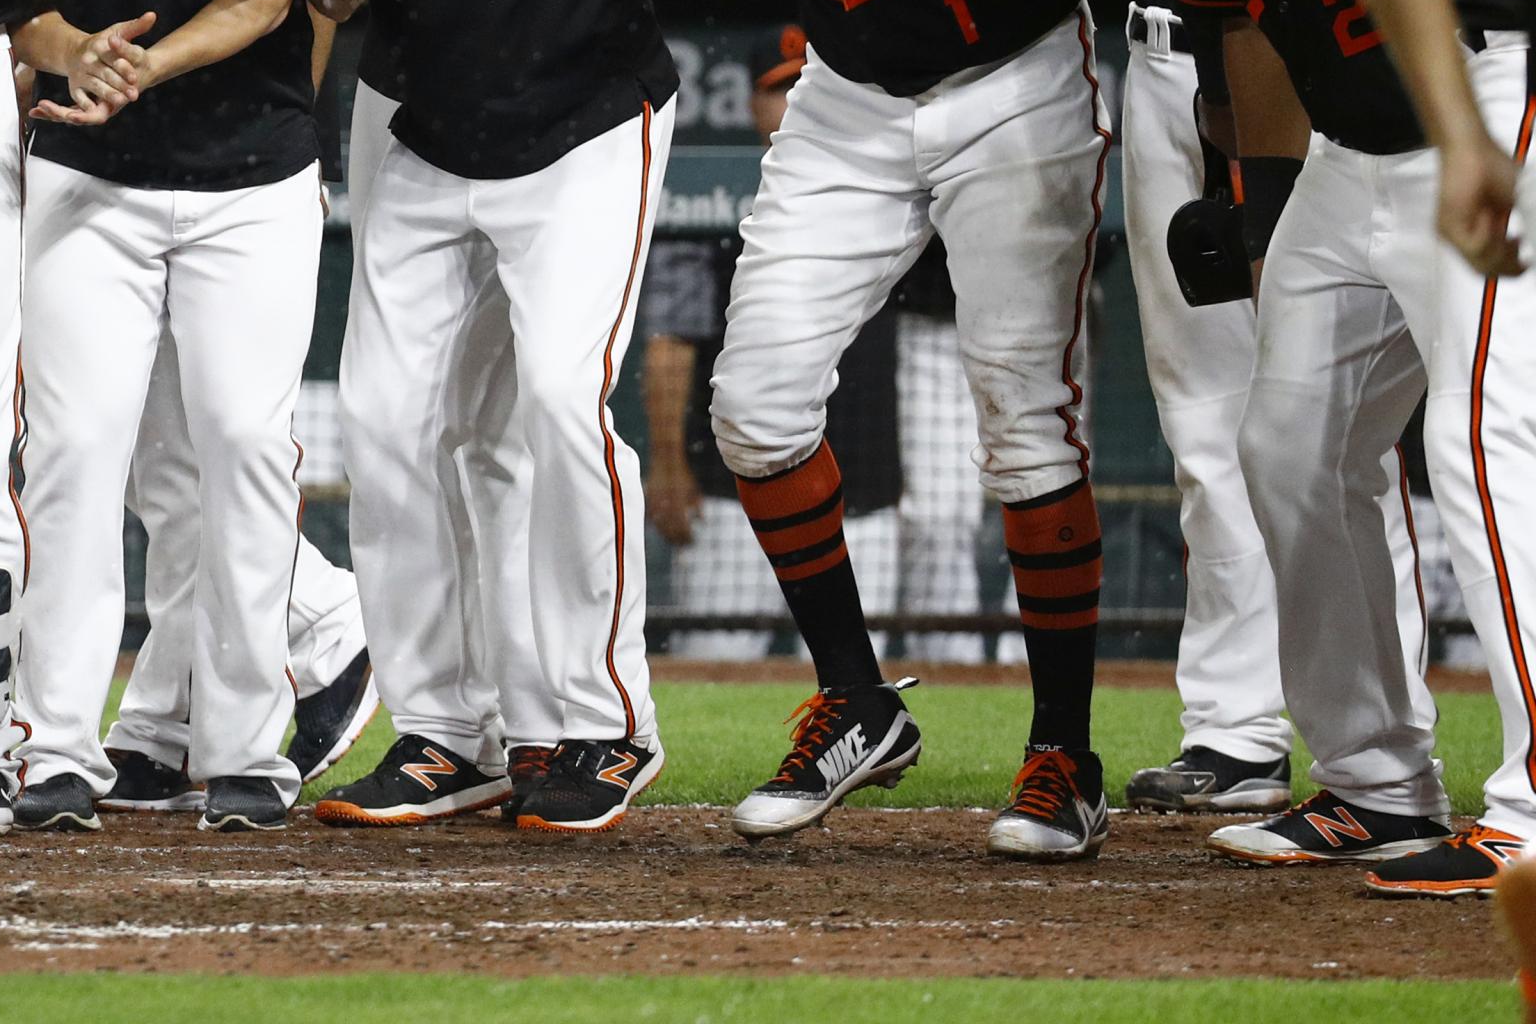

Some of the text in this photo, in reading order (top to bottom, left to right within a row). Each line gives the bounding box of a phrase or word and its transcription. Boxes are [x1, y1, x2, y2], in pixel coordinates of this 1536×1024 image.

[400, 746, 459, 792] N
[815, 722, 871, 794] NIKE
[1303, 806, 1373, 848] N
